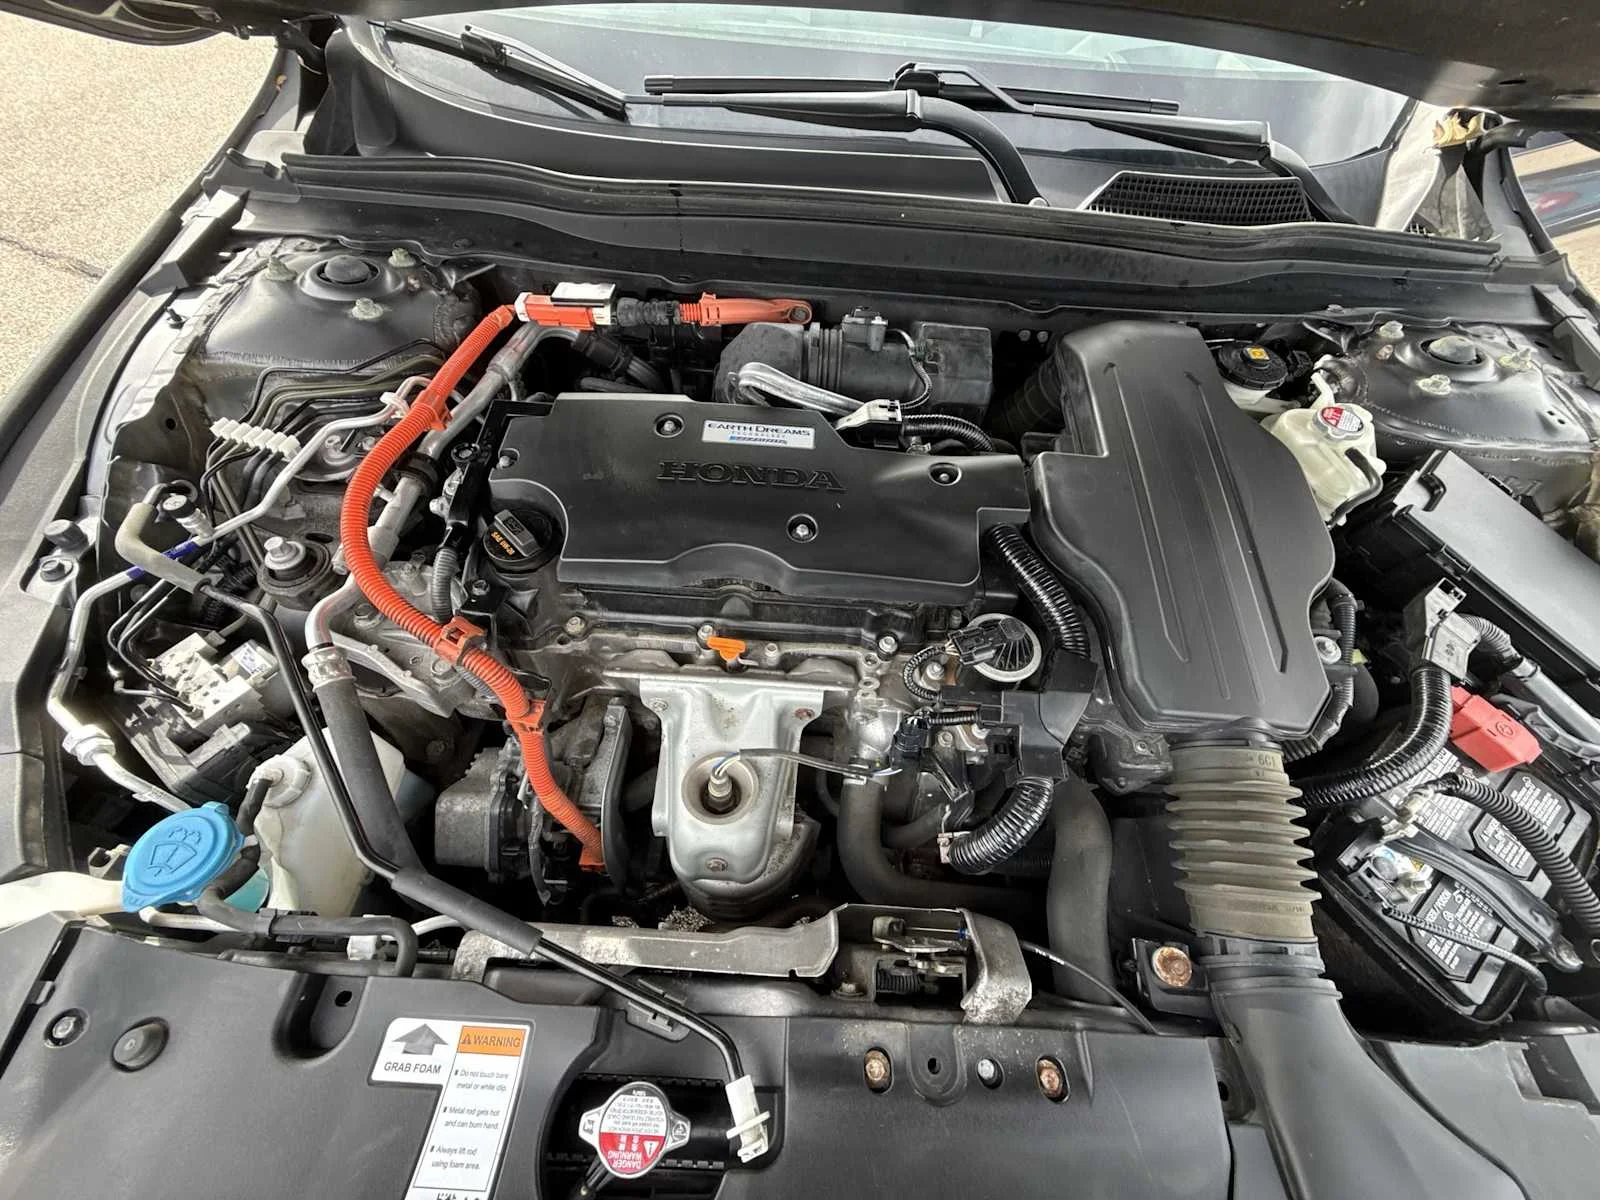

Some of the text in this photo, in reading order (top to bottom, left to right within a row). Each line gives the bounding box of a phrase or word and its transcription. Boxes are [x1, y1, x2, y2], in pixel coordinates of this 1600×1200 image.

[708, 423, 810, 436] EARTH DREAMS
[656, 460, 848, 491] HONDA
[473, 1034, 521, 1048] WARNING
[384, 1061, 442, 1074] GRAB FOAM
[448, 1107, 465, 1115] Metal
[466, 1107, 475, 1115] rod
[490, 1109, 501, 1117] hot
[436, 1146, 457, 1156] Always
[466, 1148, 478, 1156] rod
[432, 1161, 448, 1170] using
[449, 1161, 465, 1169] foam
[612, 1160, 641, 1170] DANGER
